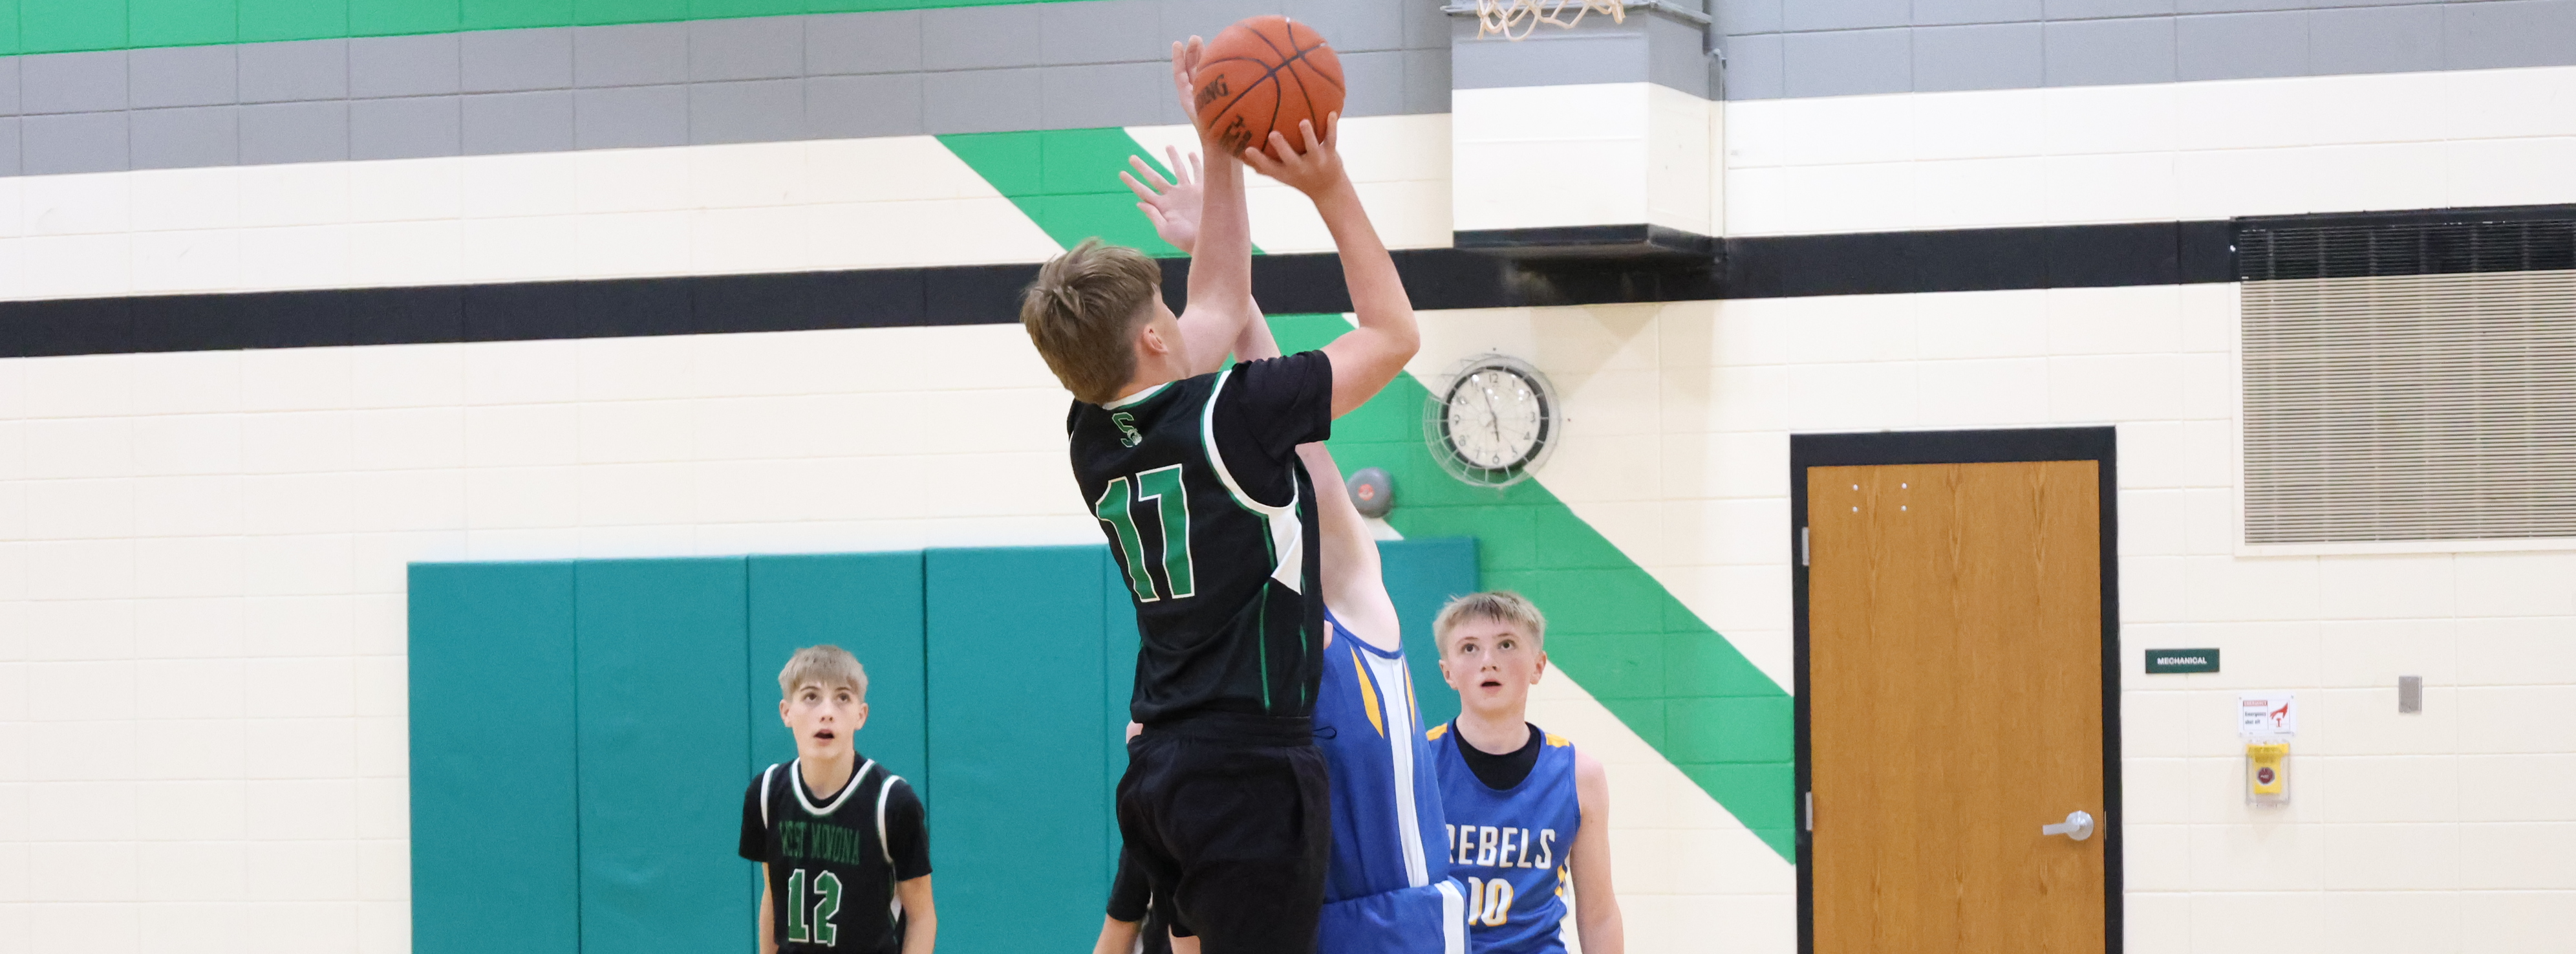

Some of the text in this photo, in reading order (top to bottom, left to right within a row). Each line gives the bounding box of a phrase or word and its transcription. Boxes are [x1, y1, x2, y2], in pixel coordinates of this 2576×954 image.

[1489, 373, 1499, 383] 12
[1458, 435, 1466, 446] 8
[1492, 453, 1500, 465] 6
[1095, 463, 1195, 603] 17
[2157, 656, 2207, 665] MECHANICAL
[788, 868, 842, 947] 12
[1468, 876, 1514, 927] 10
